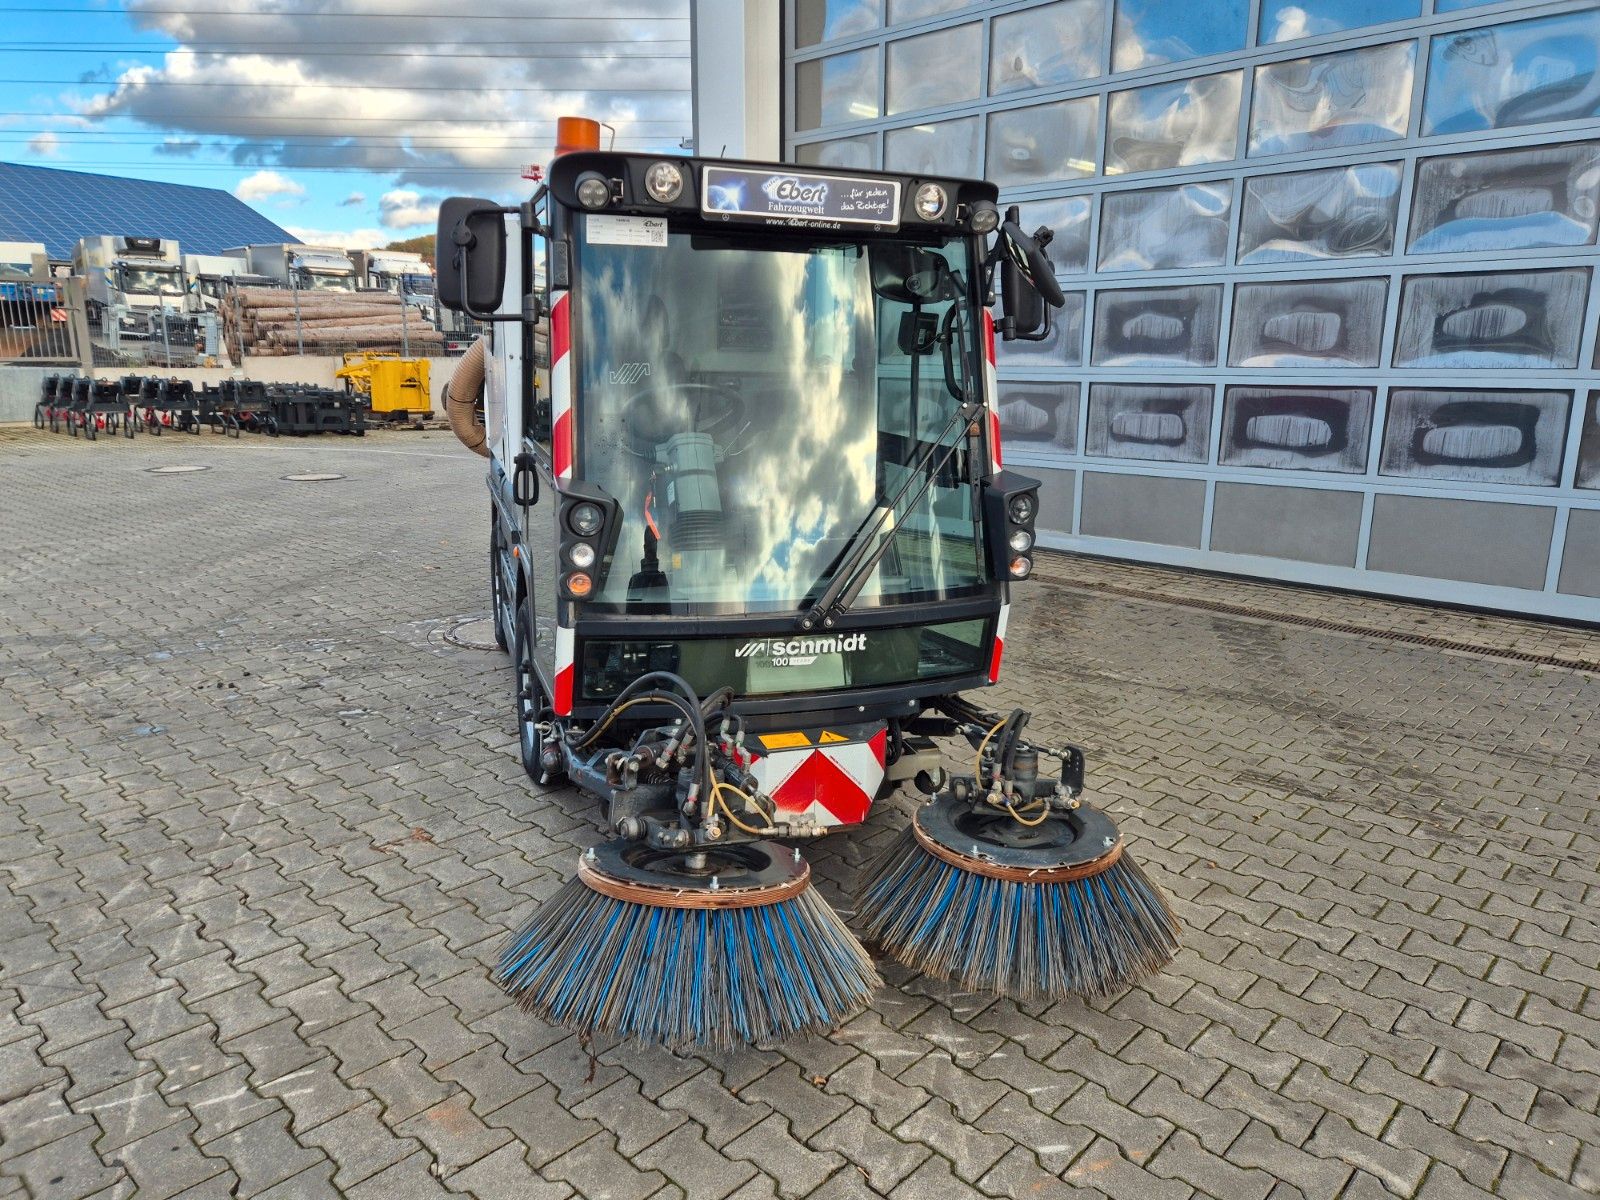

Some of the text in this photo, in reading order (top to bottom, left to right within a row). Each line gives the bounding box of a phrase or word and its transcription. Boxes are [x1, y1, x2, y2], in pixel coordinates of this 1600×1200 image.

[776, 179, 826, 203] Ebert
[865, 187, 888, 199] jeden
[767, 201, 825, 215] Fahrzeugwelt
[840, 201, 855, 211] das
[772, 633, 867, 656] schmidt
[771, 657, 789, 667] 100
